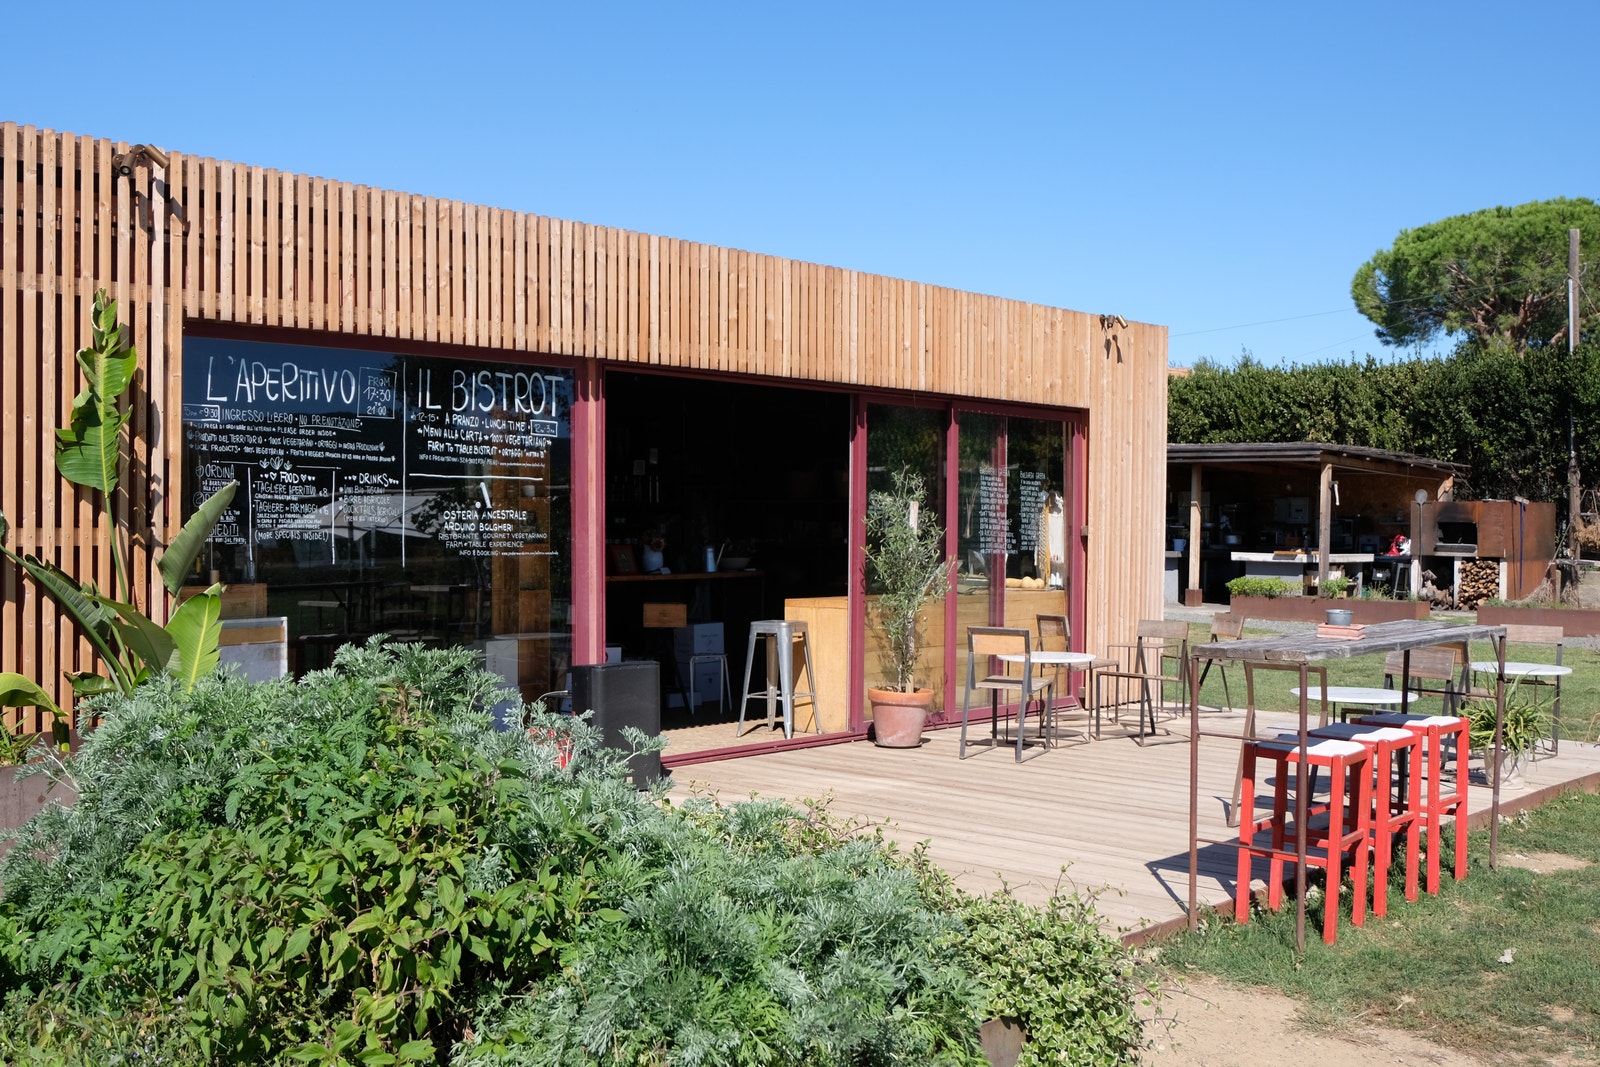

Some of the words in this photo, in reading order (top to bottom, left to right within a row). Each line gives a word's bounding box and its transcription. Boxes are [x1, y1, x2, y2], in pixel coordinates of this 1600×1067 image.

[207, 356, 356, 404] L'APERITIVO
[368, 376, 390, 387] FROM
[363, 386, 390, 402] 17:30
[418, 368, 442, 410] IL
[452, 369, 564, 418] BISTROT
[222, 408, 264, 422] INGRESSO
[266, 412, 293, 424] LIBERO
[300, 414, 308, 425] NO
[366, 406, 387, 416] 21:00
[445, 412, 450, 425] A
[452, 414, 480, 428] PRANZO
[484, 418, 506, 430] LUNCH
[508, 420, 527, 432] TIME
[278, 426, 297, 435] PLEASE
[219, 434, 229, 444] DEL
[229, 434, 262, 444] TERRITORIO
[443, 429, 459, 441] ALLA
[460, 430, 483, 444] CARTA
[504, 434, 547, 448] VEGETARIANO
[210, 444, 238, 454] PRODUCTS
[427, 440, 444, 452] FARM
[454, 443, 473, 455] TABLE
[205, 464, 235, 478] ORDINA
[280, 472, 300, 484] FOOD
[359, 472, 389, 487] DRINKS
[288, 484, 316, 496] APERITIVO
[290, 503, 318, 514] FORMAGGI
[443, 510, 480, 521] OSTERIA
[482, 510, 528, 521] ANCESTRALE
[443, 520, 476, 532] ARDUINO
[479, 522, 514, 532] BOLGHERI
[254, 530, 273, 544] (MORE
[438, 532, 479, 541] RISTORANTE
[482, 532, 510, 540] GOURMET
[511, 532, 548, 540] VEGETARIANO
[446, 540, 464, 549] FARM
[470, 540, 486, 548] TABLE
[489, 540, 525, 548] EXPERIENCE
